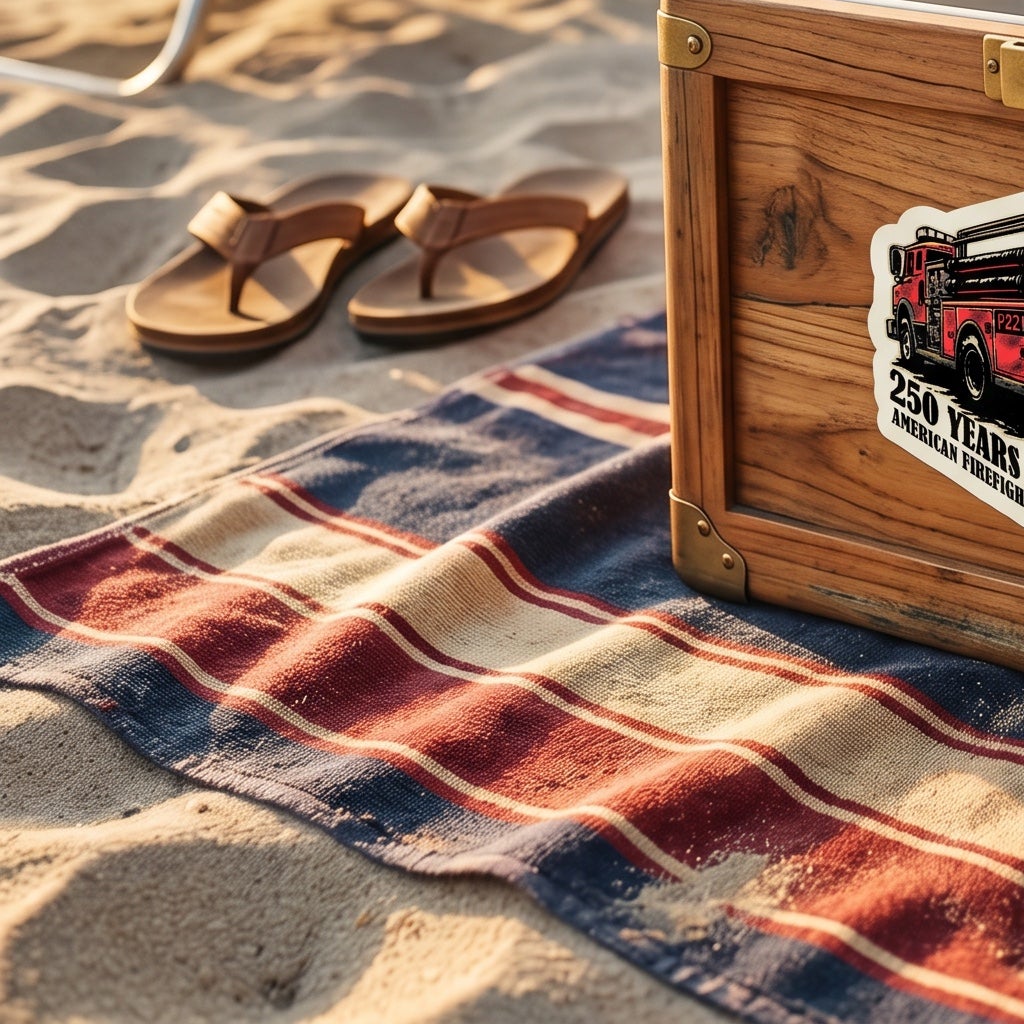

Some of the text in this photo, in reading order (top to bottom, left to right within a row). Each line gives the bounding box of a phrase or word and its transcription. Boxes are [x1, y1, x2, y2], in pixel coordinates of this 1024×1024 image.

[997, 313, 1024, 332] P221
[889, 368, 939, 426] 250
[947, 405, 1021, 479] YEARS
[891, 407, 958, 464] AMERICAN
